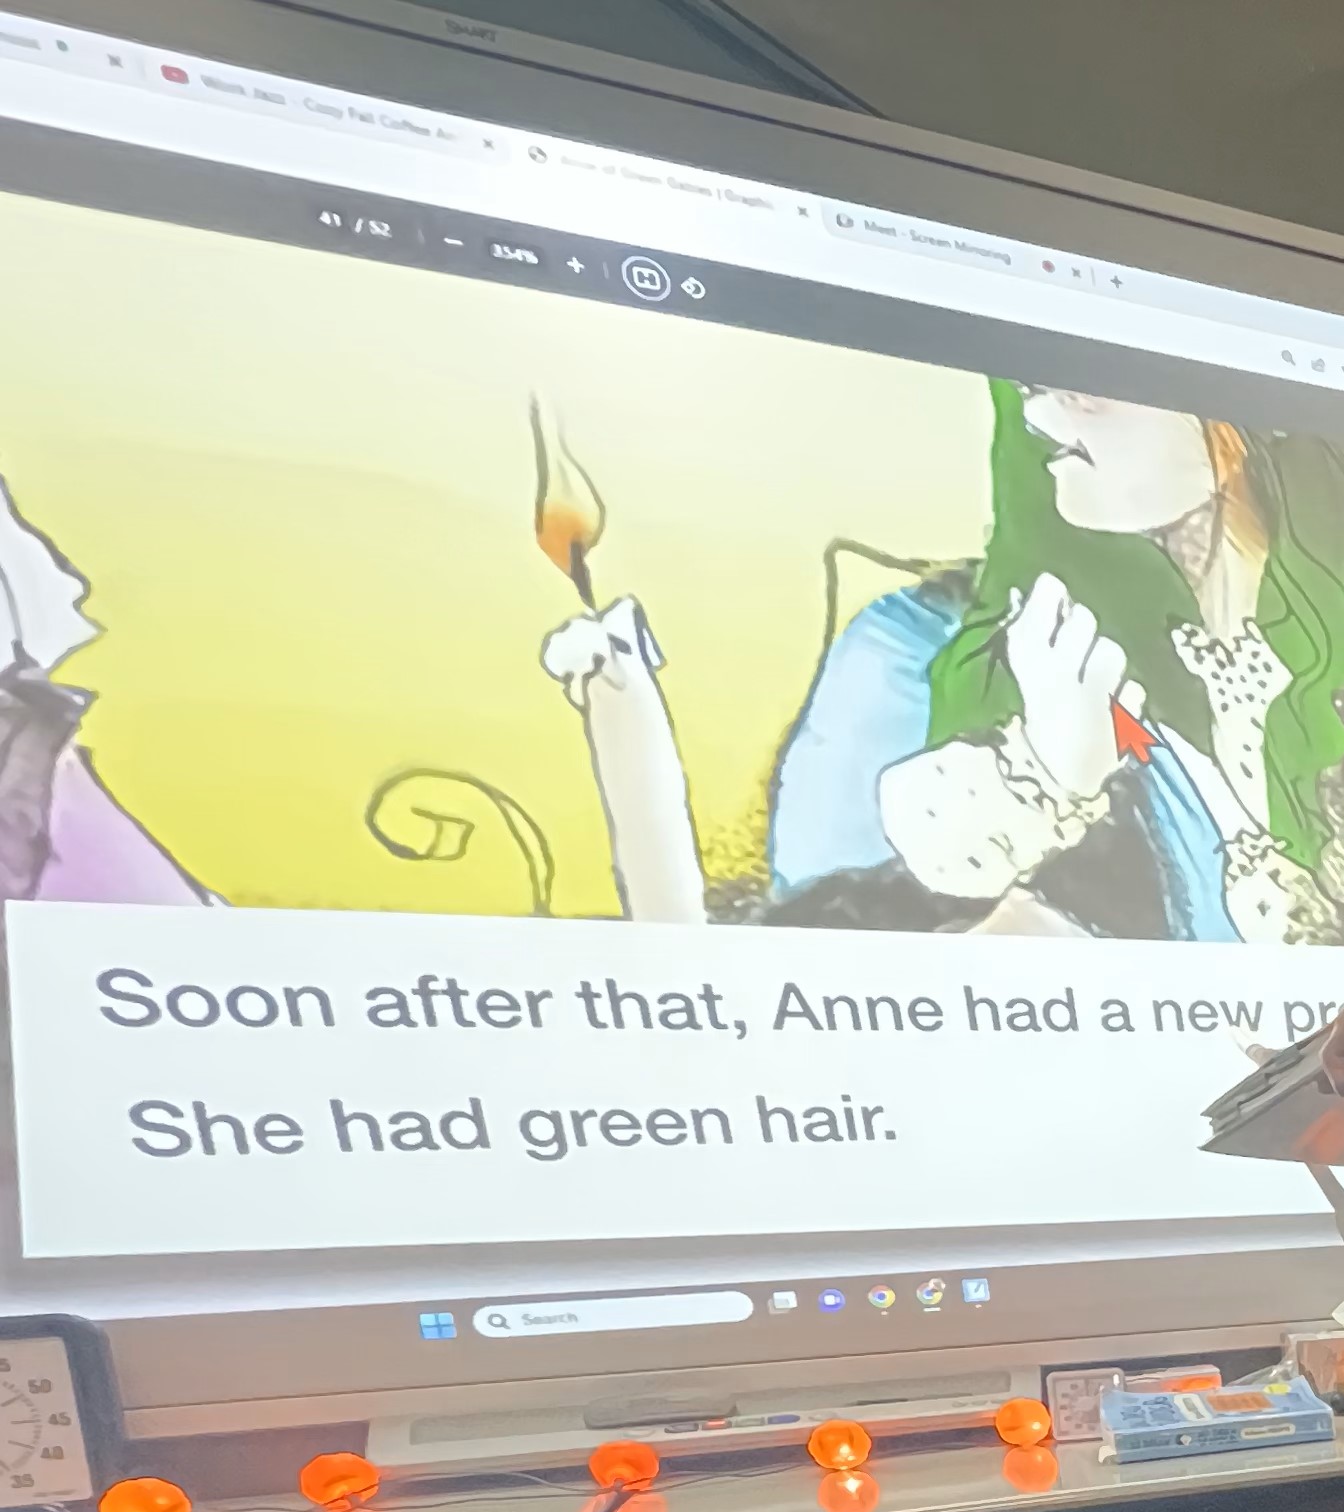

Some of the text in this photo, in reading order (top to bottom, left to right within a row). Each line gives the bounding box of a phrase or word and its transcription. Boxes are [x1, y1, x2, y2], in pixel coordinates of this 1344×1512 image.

[908, 228, 952, 249] Screen
[95, 967, 335, 1029] Soon
[364, 974, 554, 1030] after
[574, 977, 749, 1040] that,
[772, 981, 945, 1033] Anne
[963, 985, 1080, 1034] had
[1100, 996, 1135, 1034] a
[1154, 1001, 1265, 1034] new
[127, 1094, 898, 1162] She had green hair.
[520, 1311, 579, 1326] Search
[28, 1378, 52, 1394] 50
